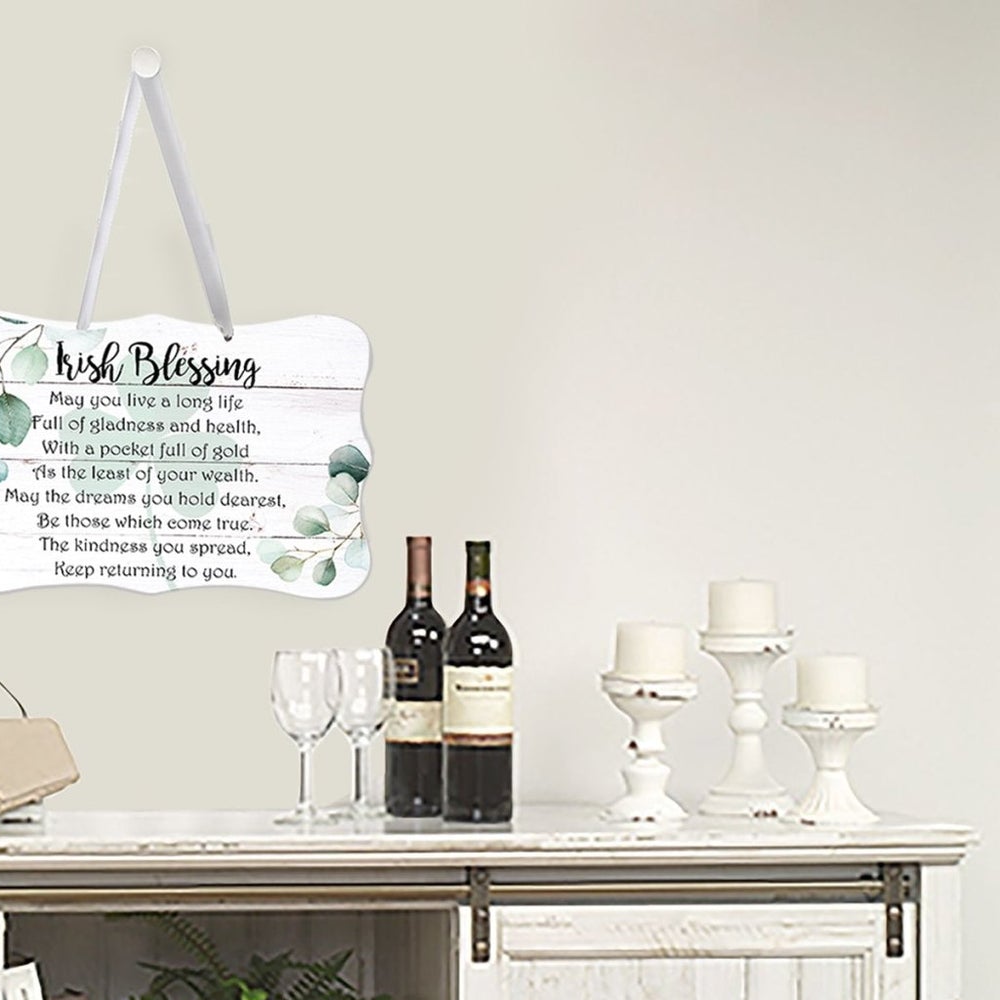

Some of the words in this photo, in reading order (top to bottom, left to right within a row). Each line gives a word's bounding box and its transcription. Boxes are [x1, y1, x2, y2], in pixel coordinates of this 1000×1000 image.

[55, 340, 124, 383] Irish
[128, 341, 261, 389] Blessing
[49, 390, 84, 410] May
[90, 395, 121, 410] you
[127, 392, 156, 409] live
[161, 396, 171, 408] a
[176, 393, 213, 413] long
[218, 394, 244, 413] life
[32, 414, 63, 431] Full
[68, 416, 85, 434] of
[90, 417, 165, 435] gladness
[169, 418, 200, 433] and
[206, 419, 261, 435] health,
[42, 439, 79, 455] With
[85, 444, 95, 456] a
[100, 441, 154, 459] pocket
[160, 442, 185, 460] full
[191, 443, 208, 460] of
[213, 444, 249, 461] gold
[32, 464, 56, 480] As
[62, 465, 86, 481] the
[92, 466, 130, 481] least
[135, 466, 153, 484] of
[157, 469, 197, 485] your
[201, 468, 259, 483] wealth.
[4, 488, 40, 506] May
[45, 489, 70, 504] the
[75, 490, 136, 505] dreams
[141, 494, 172, 508] you
[178, 491, 215, 506] hold
[220, 492, 286, 508] dearest,
[36, 512, 60, 529] Be
[65, 513, 111, 529] those
[114, 515, 162, 529] which
[167, 519, 212, 531] come
[217, 517, 253, 532] true.
[38, 536, 70, 553] The
[74, 538, 148, 554] kindness
[152, 543, 184, 556] you
[189, 541, 251, 557] spread,
[55, 561, 95, 579] Keep
[100, 563, 177, 580] returning
[182, 565, 198, 578] to
[202, 567, 237, 582] you.
